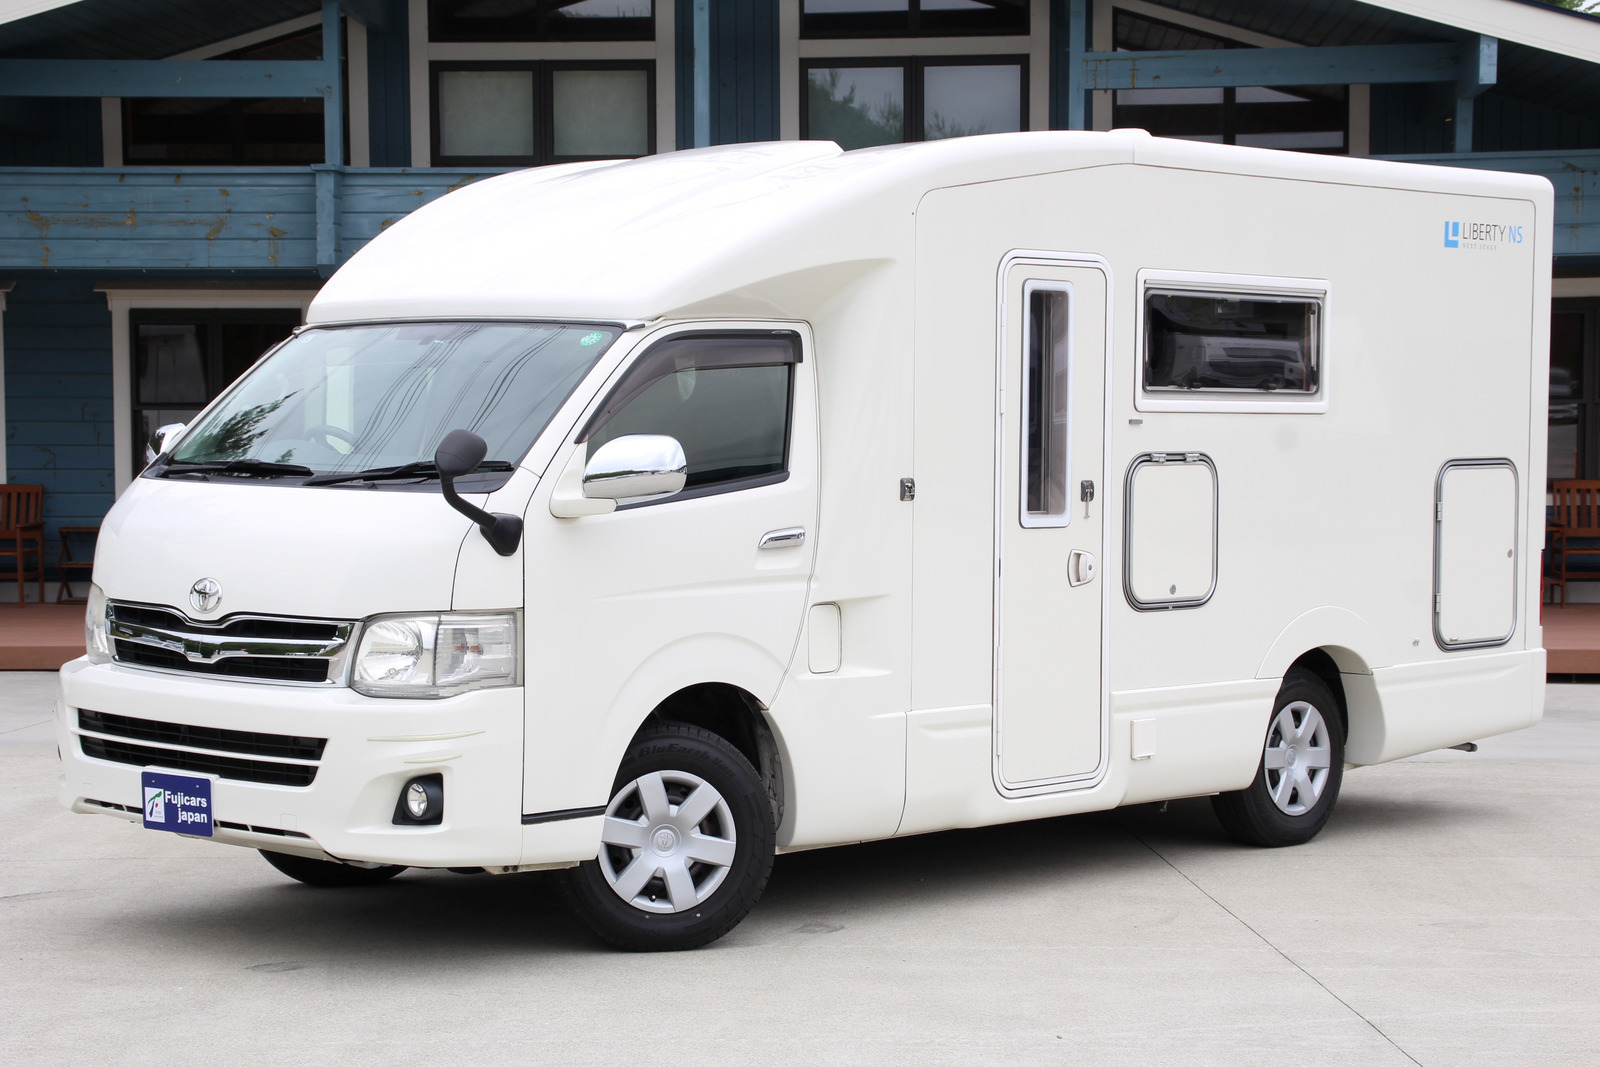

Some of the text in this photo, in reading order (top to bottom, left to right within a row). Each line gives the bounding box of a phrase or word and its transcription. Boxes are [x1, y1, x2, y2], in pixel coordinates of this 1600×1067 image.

[1462, 222, 1523, 244] LIBERTY NS
[164, 790, 208, 808] Fujicars
[177, 808, 208, 824] japan
